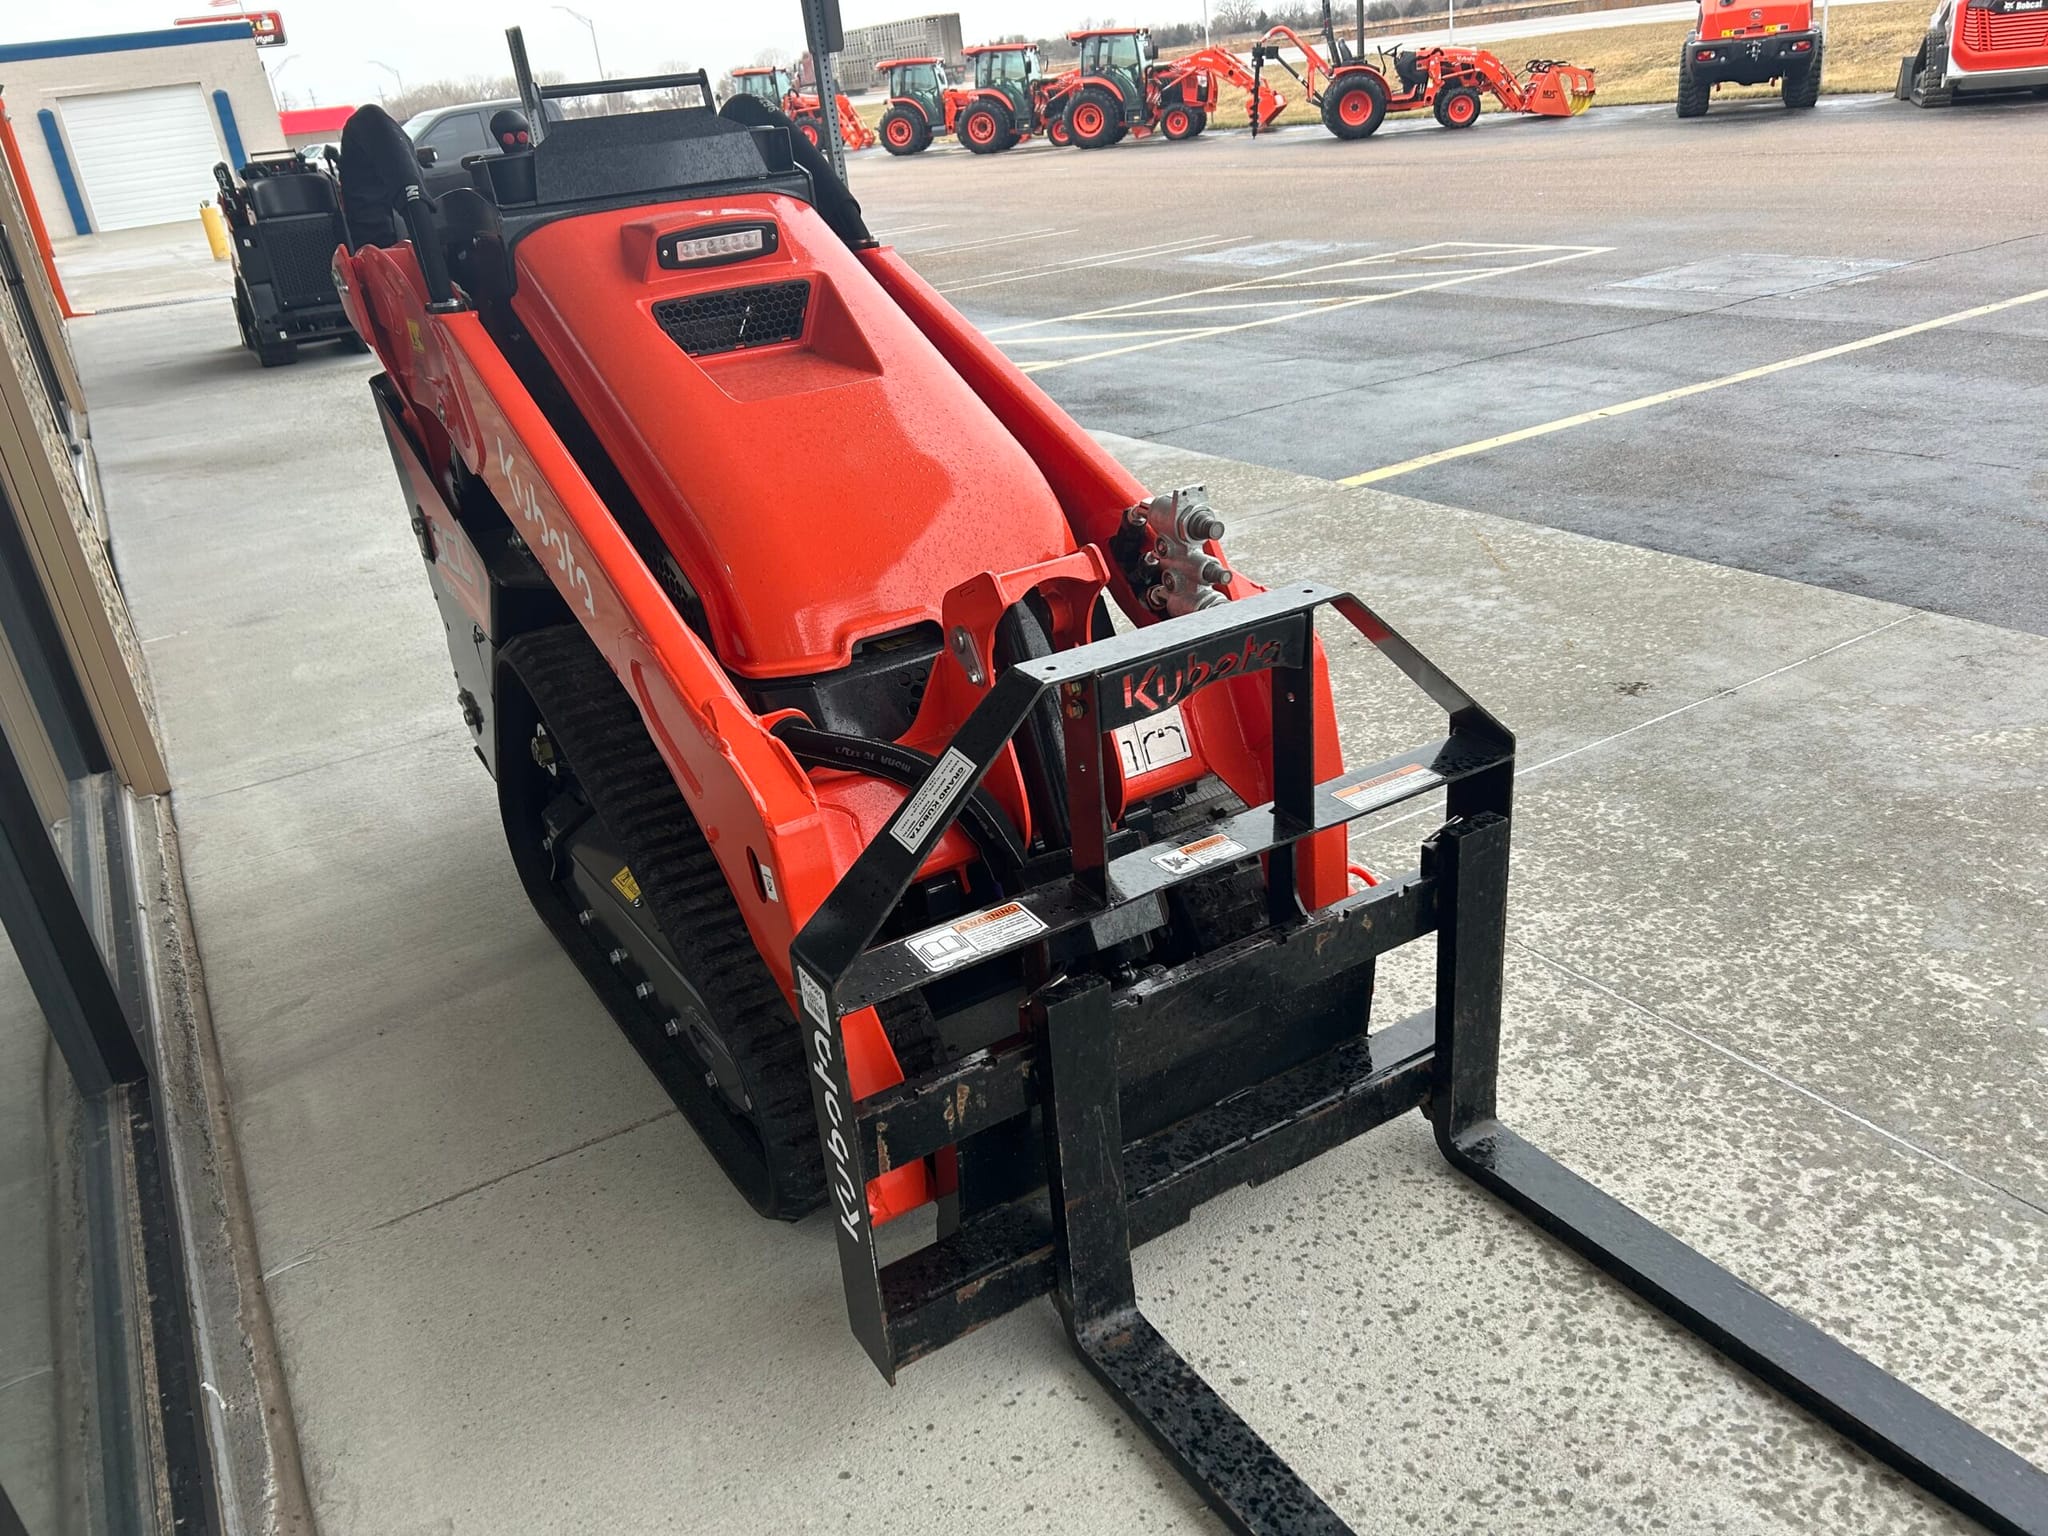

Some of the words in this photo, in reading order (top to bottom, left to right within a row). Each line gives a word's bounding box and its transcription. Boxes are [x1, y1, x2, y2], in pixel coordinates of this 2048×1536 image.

[2016, 1, 2043, 10] Bobcat
[496, 436, 595, 617] Kubota
[1122, 634, 1281, 711] Kubota
[939, 766, 964, 800] GRAND
[909, 800, 940, 839] KUBOTA
[967, 904, 1018, 926] WARNING
[813, 1029, 860, 1243] Kubota
